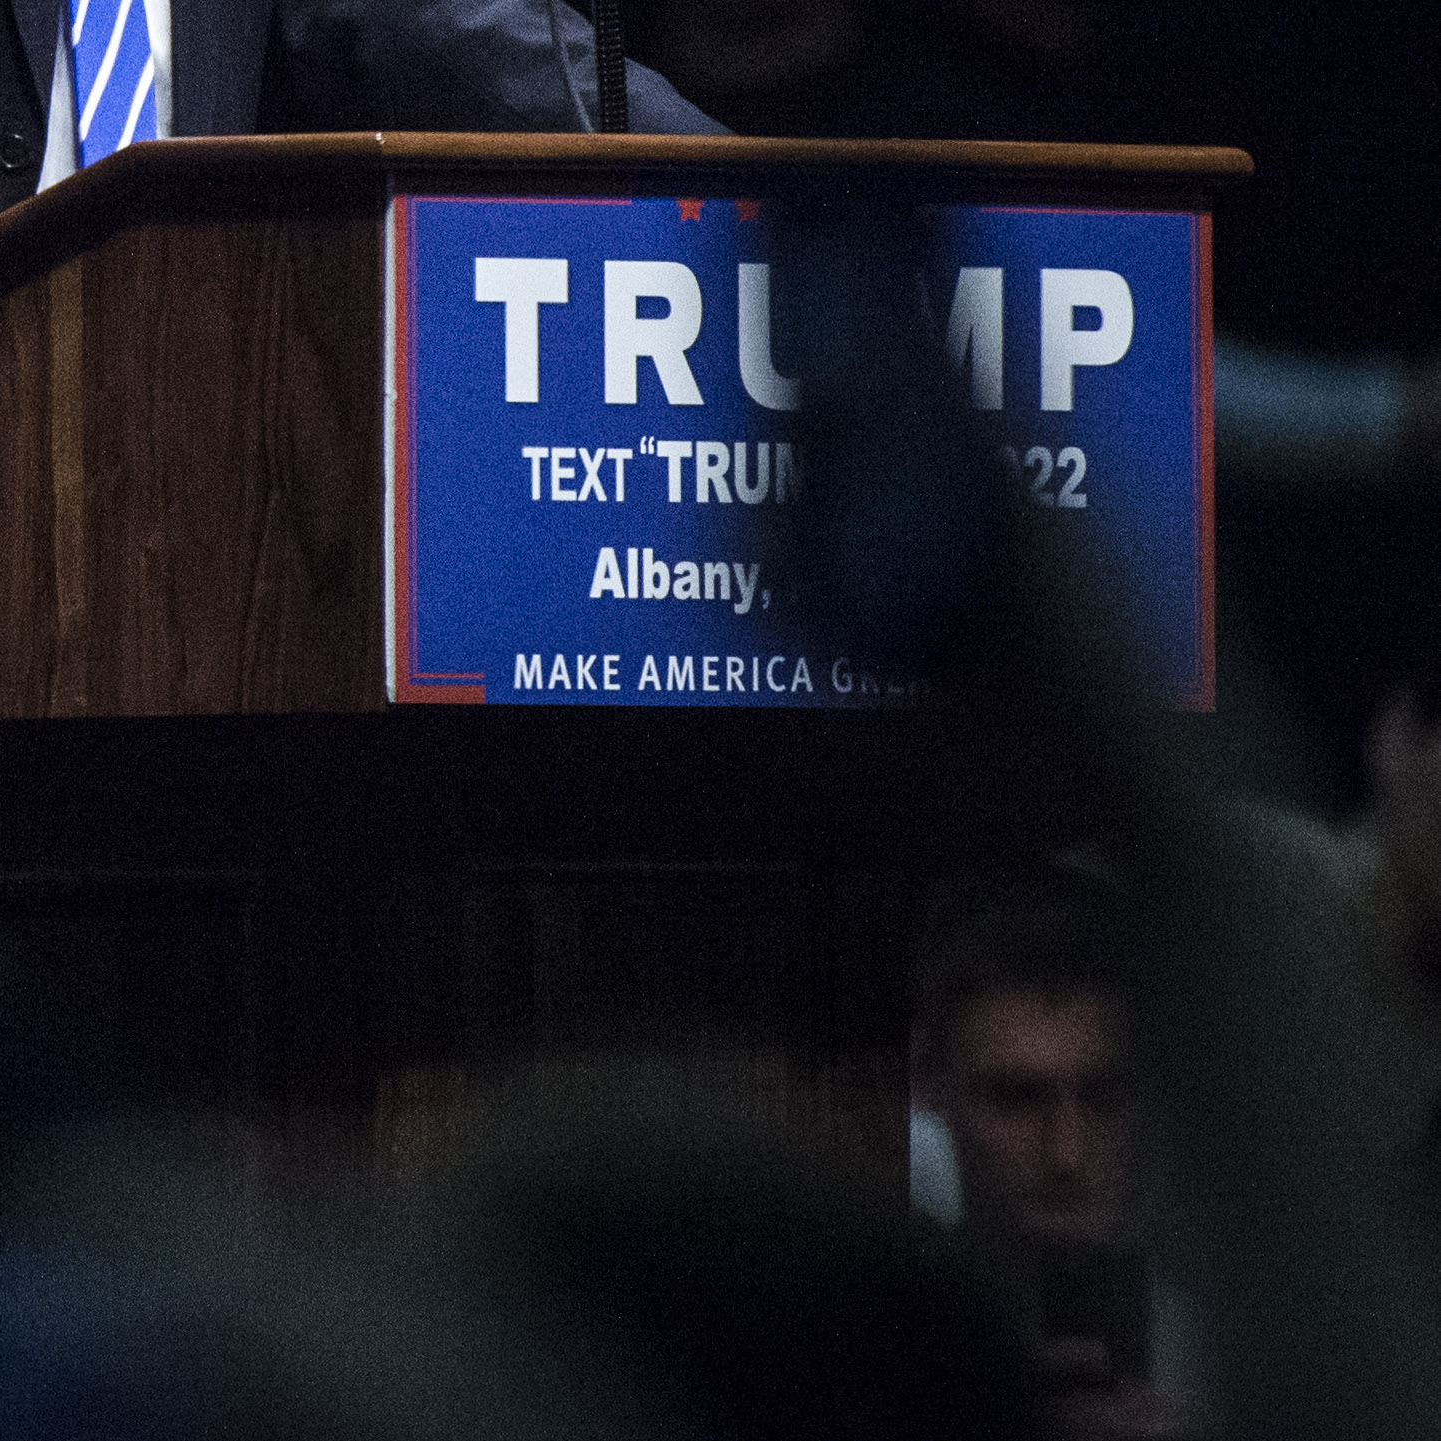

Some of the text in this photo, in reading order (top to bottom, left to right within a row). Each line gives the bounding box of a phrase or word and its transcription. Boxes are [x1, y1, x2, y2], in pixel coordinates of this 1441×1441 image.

[521, 445, 634, 503] TEXT
[589, 546, 772, 615] Albany,
[513, 653, 623, 692] MAKE
[637, 653, 815, 693] AMERICA
